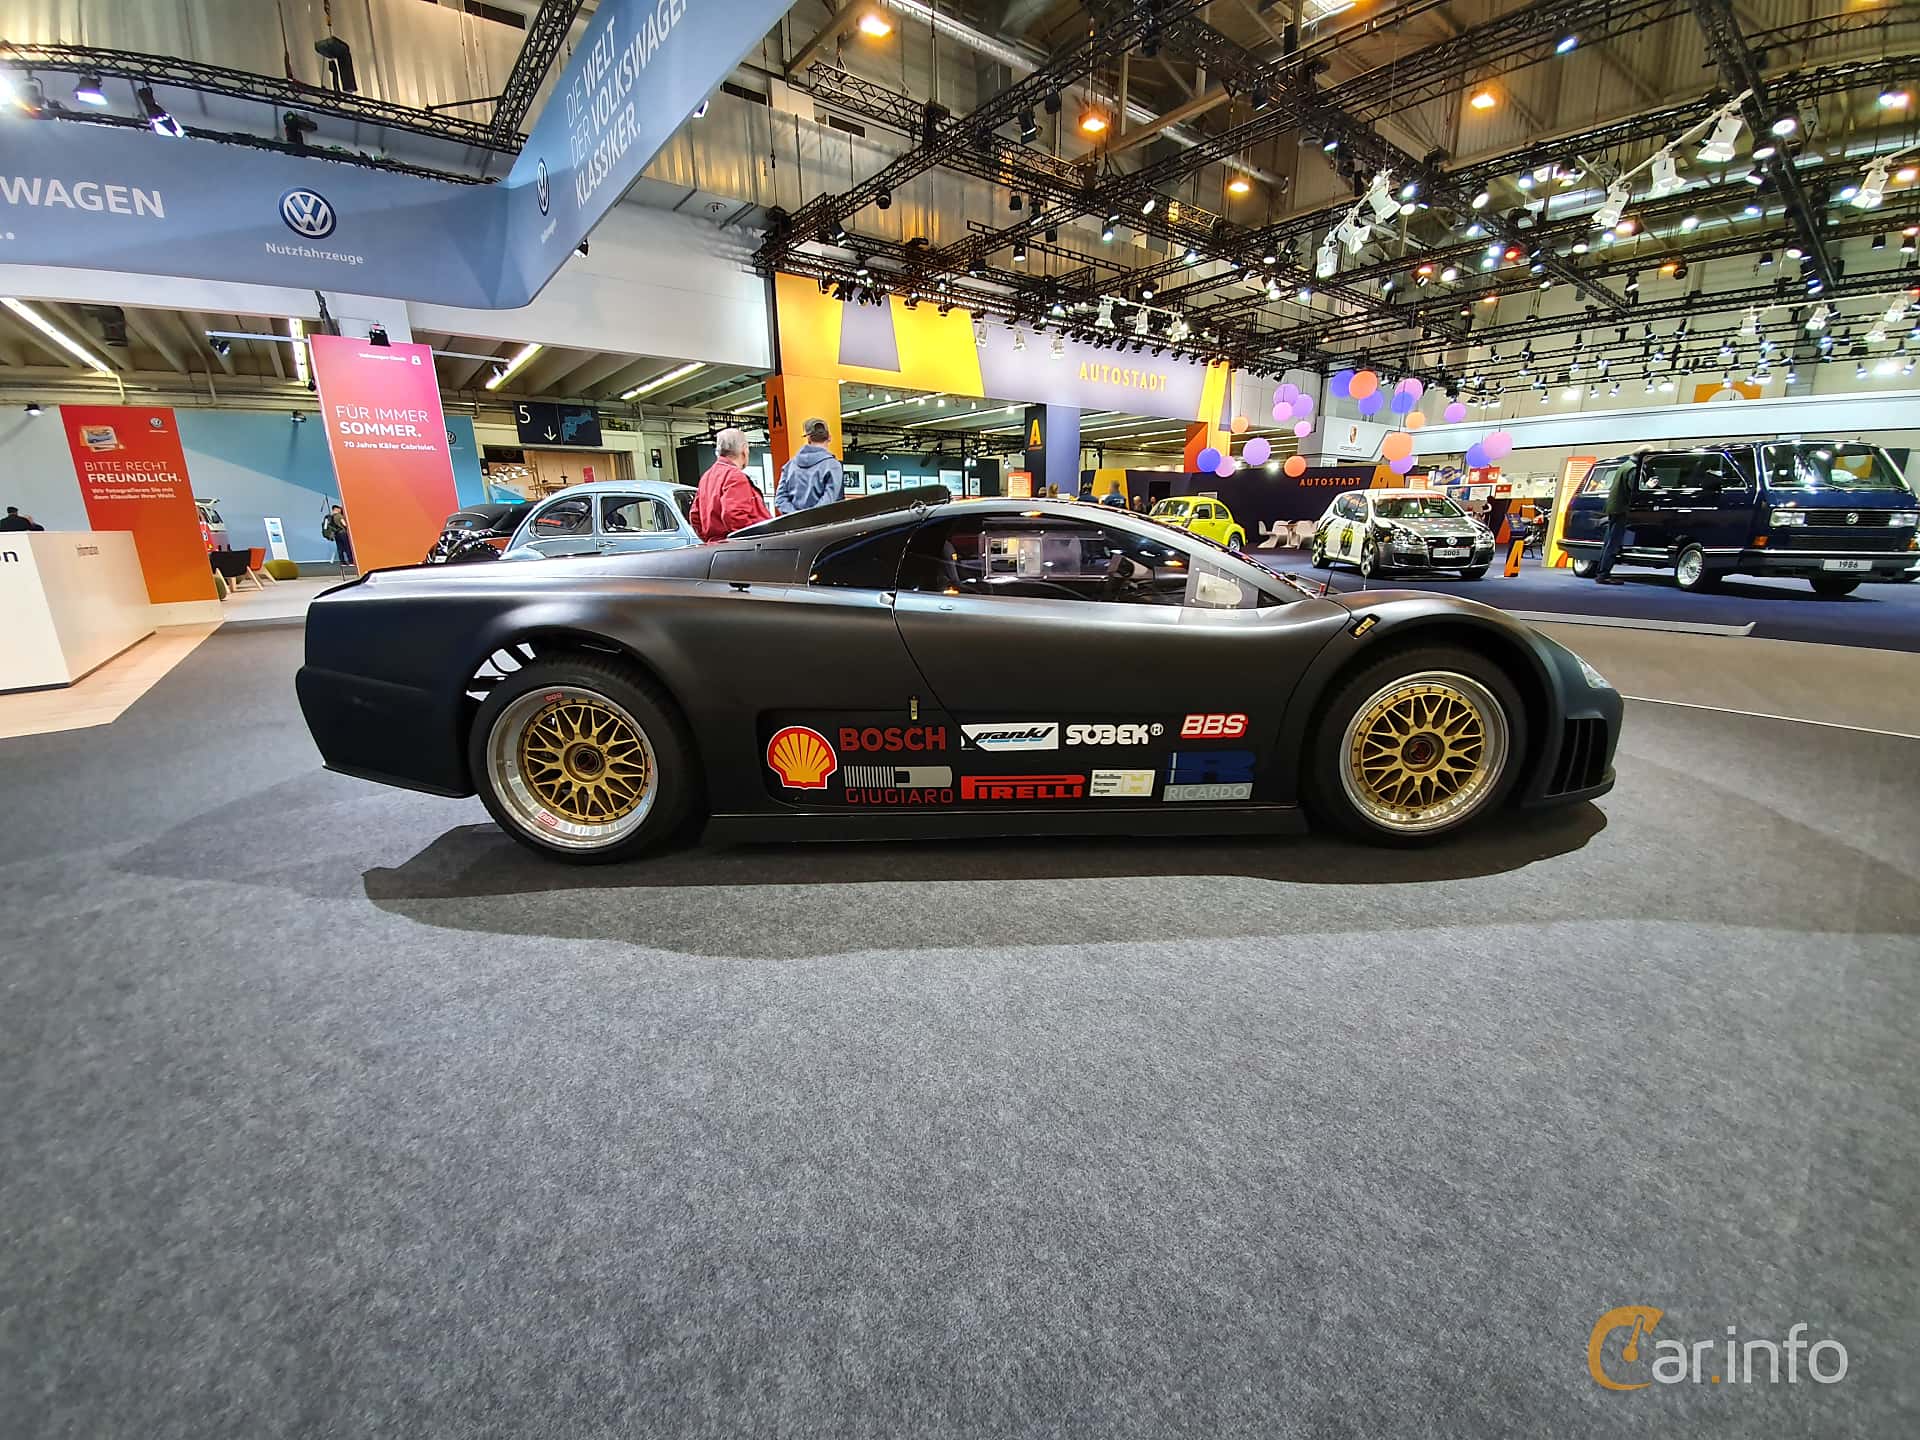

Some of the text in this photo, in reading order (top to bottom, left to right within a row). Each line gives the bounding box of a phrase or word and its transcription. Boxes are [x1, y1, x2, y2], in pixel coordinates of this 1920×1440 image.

[566, 16, 616, 128] DIE WELT
[570, 115, 592, 169] DER
[575, 101, 641, 208] KLASSIKER.
[265, 242, 365, 266] Nutzfahrzeuge
[1079, 361, 1168, 392] AUTOSTADT
[335, 403, 430, 424] FÜR IMMER
[519, 405, 531, 424] 5
[339, 421, 423, 438] SOMMER.
[1030, 418, 1042, 446] A
[84, 461, 168, 472] BITTE RECHT
[88, 472, 182, 483] FREUNDLICH.
[1300, 477, 1361, 488] AUTOSTADT
[1840, 560, 1858, 568] 1986
[1181, 714, 1247, 736] BBS
[839, 726, 946, 751] BOSCH
[846, 788, 953, 803] GIUGIARO
[960, 774, 1086, 800] PIRELLI
[1167, 785, 1248, 800] RICARDO
